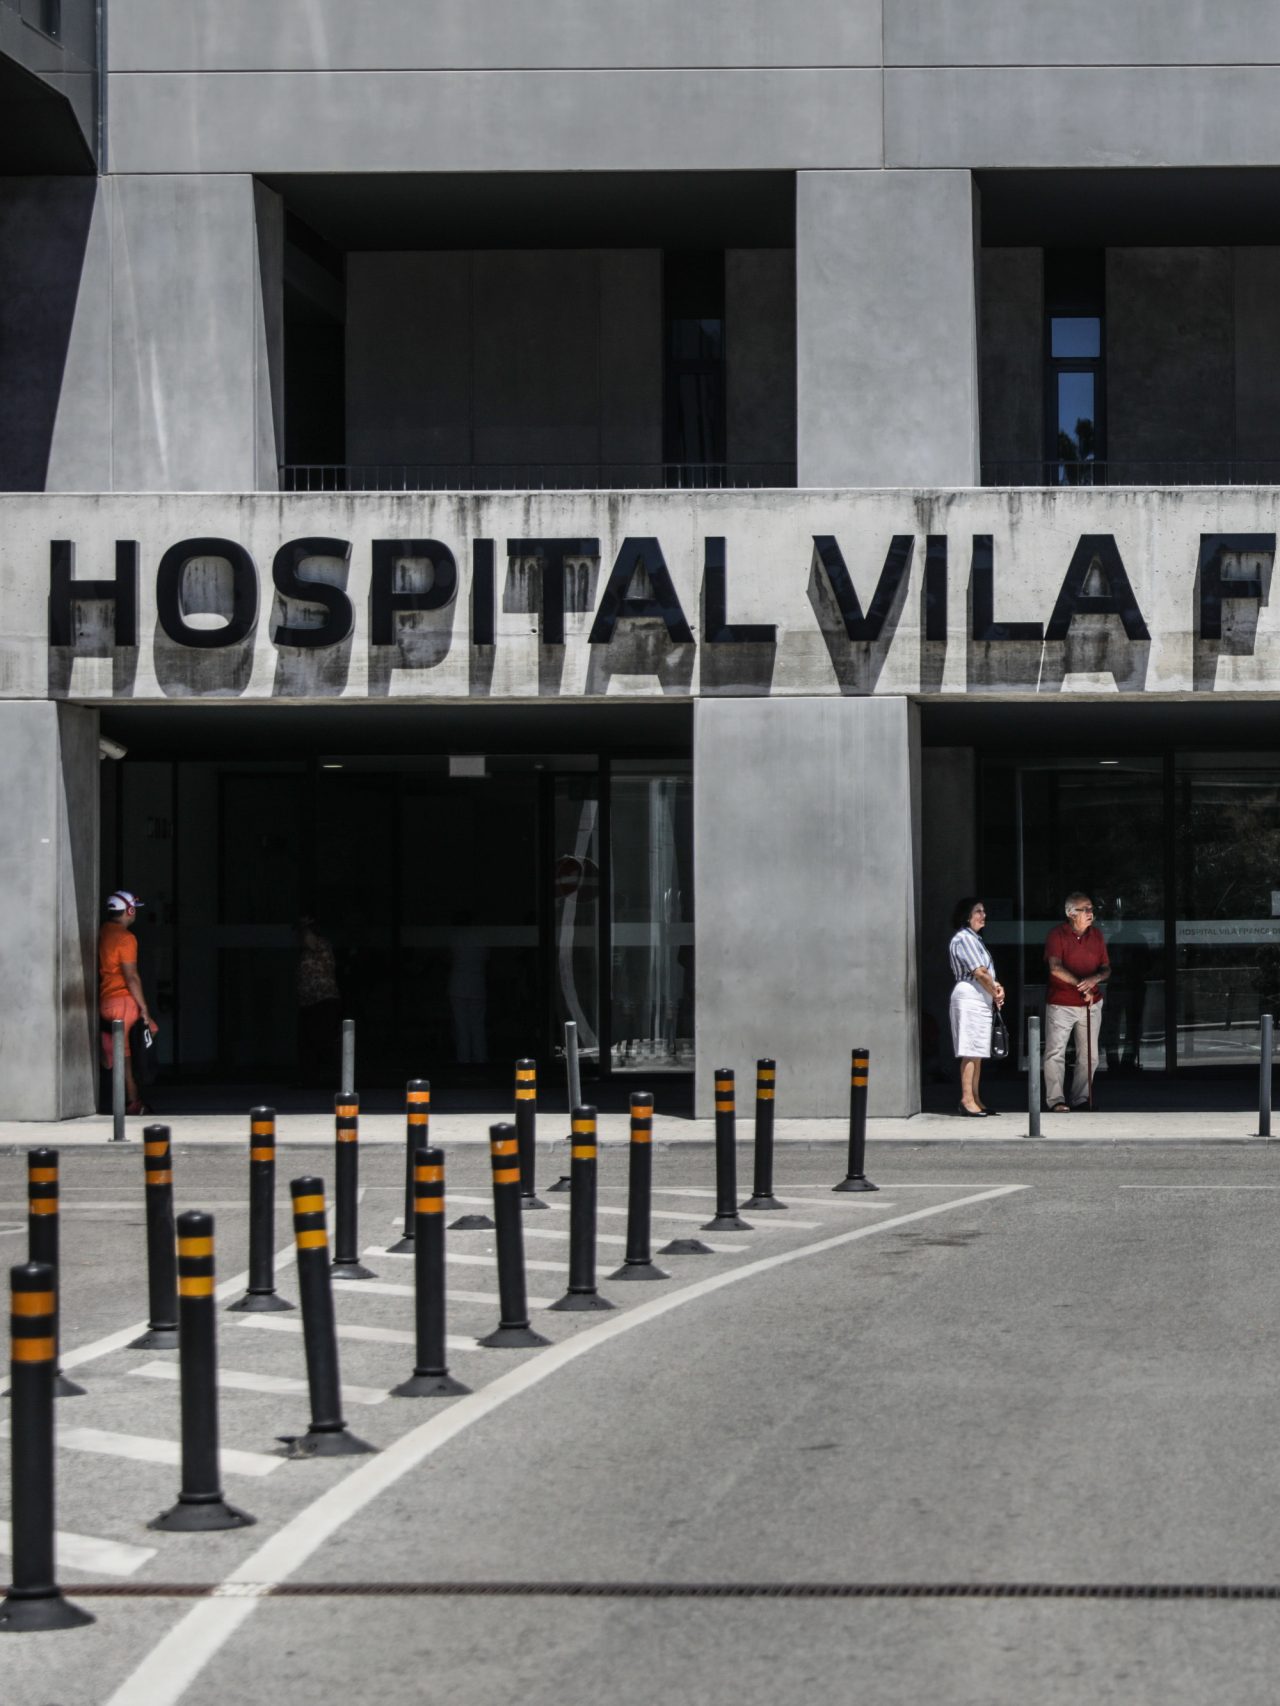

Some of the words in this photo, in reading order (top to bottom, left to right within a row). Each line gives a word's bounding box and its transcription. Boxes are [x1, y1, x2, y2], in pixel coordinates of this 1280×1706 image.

[50, 536, 778, 648] HOSPITAL
[812, 532, 1152, 642] VILA
[1179, 928, 1217, 936] HOSPITAL
